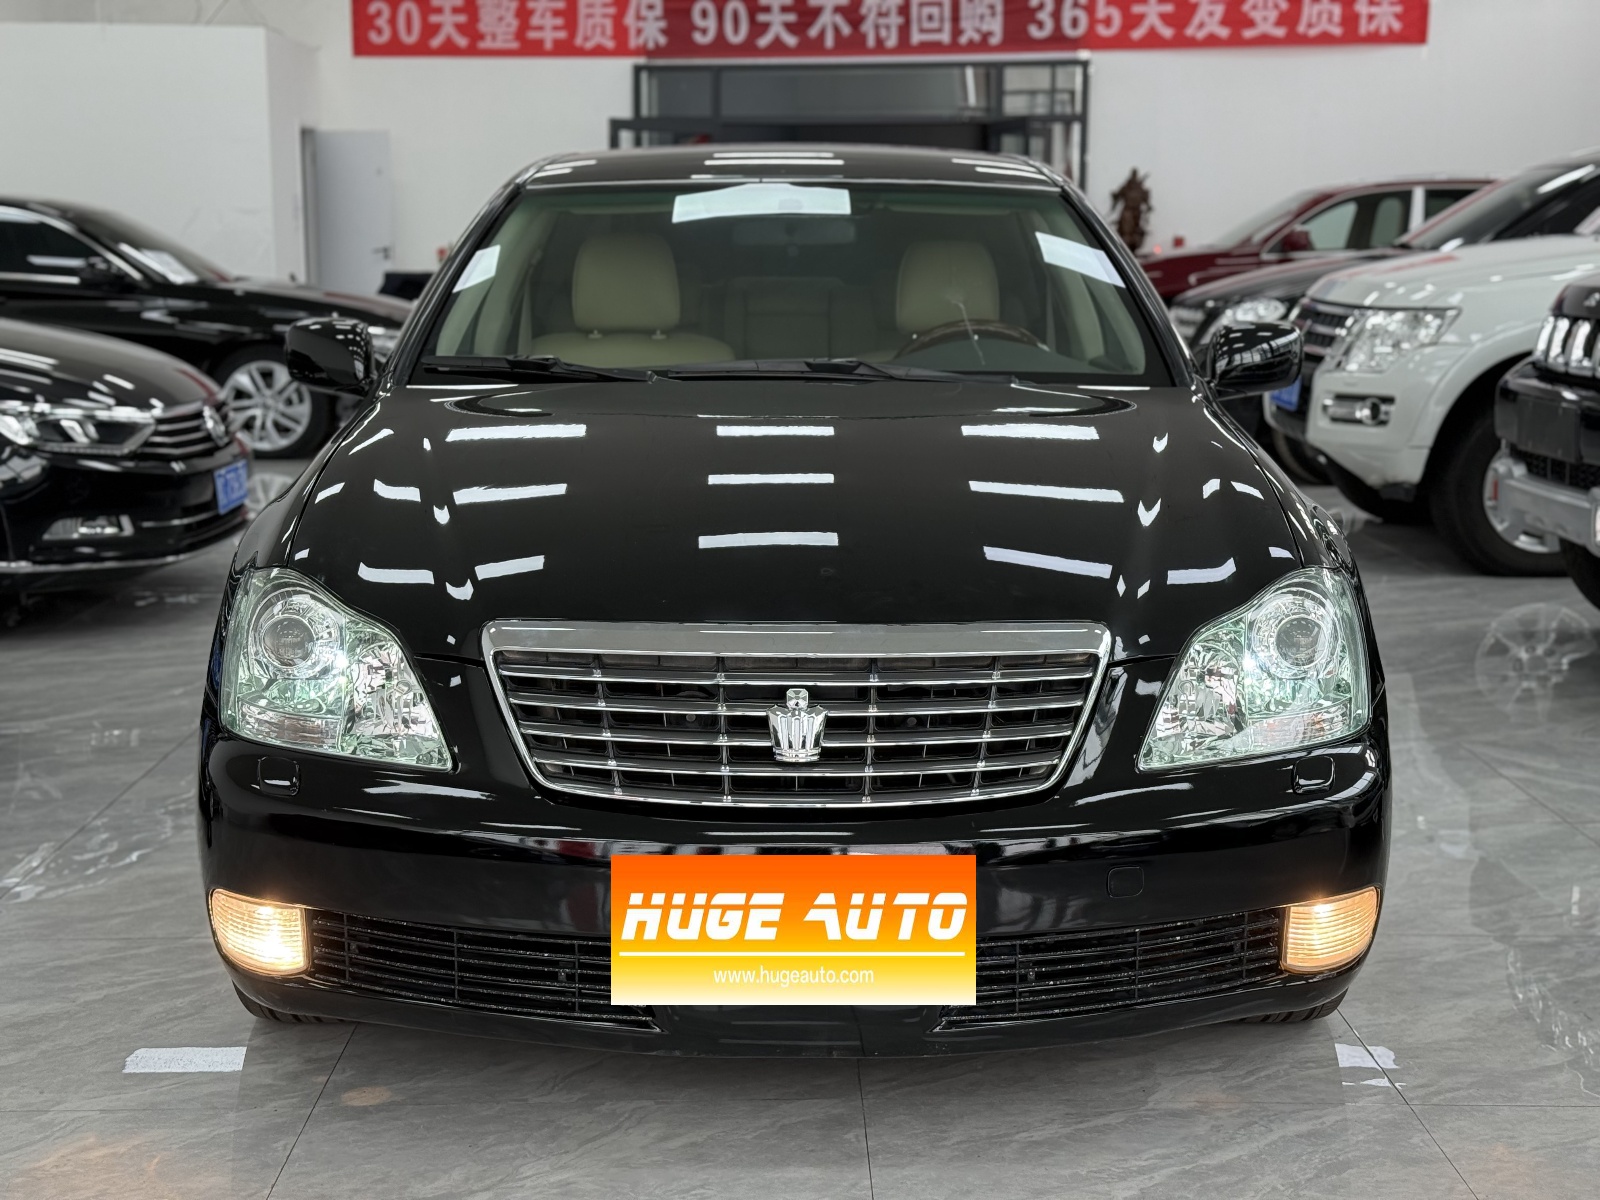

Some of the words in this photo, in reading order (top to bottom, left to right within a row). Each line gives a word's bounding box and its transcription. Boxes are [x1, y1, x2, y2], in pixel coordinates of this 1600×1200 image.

[366, 0, 668, 50] 30天整车质保
[690, 0, 1005, 49] 90天不符回购
[1027, 0, 1404, 40] 365天发变质保
